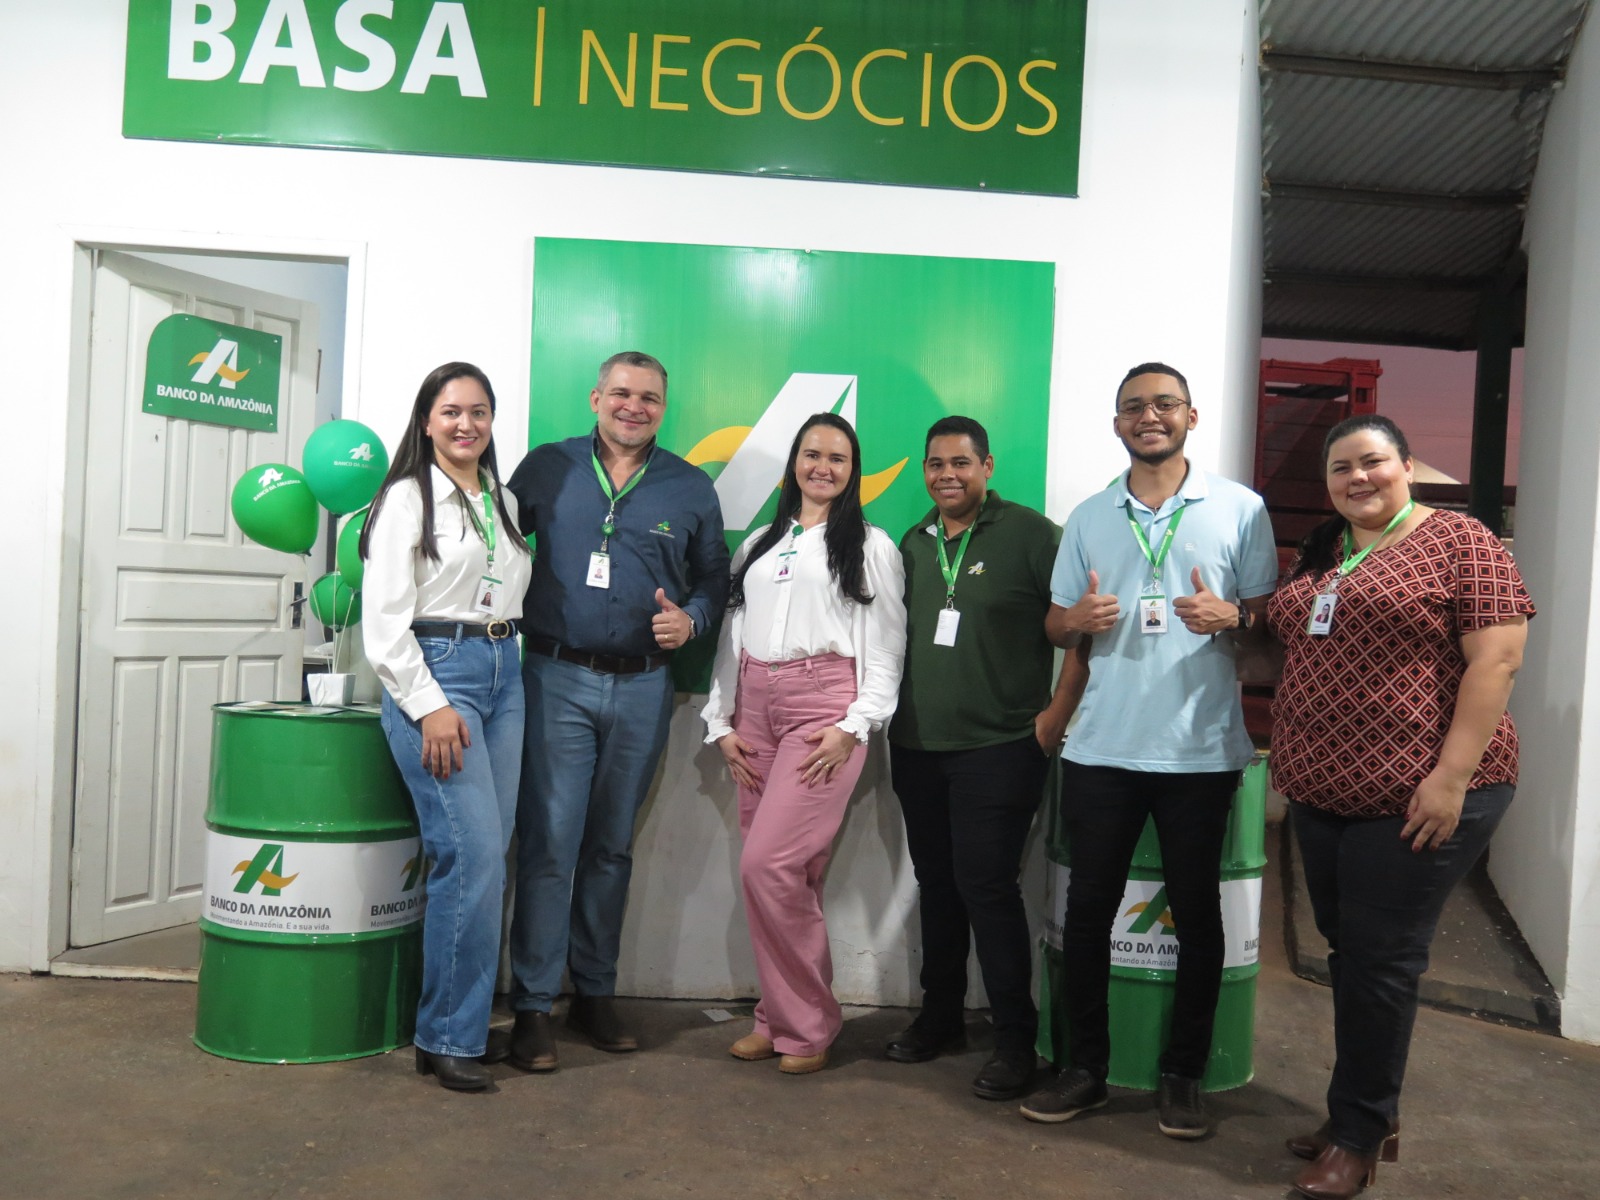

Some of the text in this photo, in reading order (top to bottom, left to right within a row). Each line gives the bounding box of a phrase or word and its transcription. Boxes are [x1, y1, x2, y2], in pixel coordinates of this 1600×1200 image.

[167, 0, 1058, 136] BASA NEGÓCIOS
[156, 384, 273, 415] BANCO DA AMAZÔNIA
[210, 895, 332, 919] BANCO DA AMAZÔNIA
[370, 900, 407, 917] BANCO
[1110, 939, 1133, 953] NCO
[1136, 942, 1154, 954] DA
[1111, 956, 1140, 965] entando
